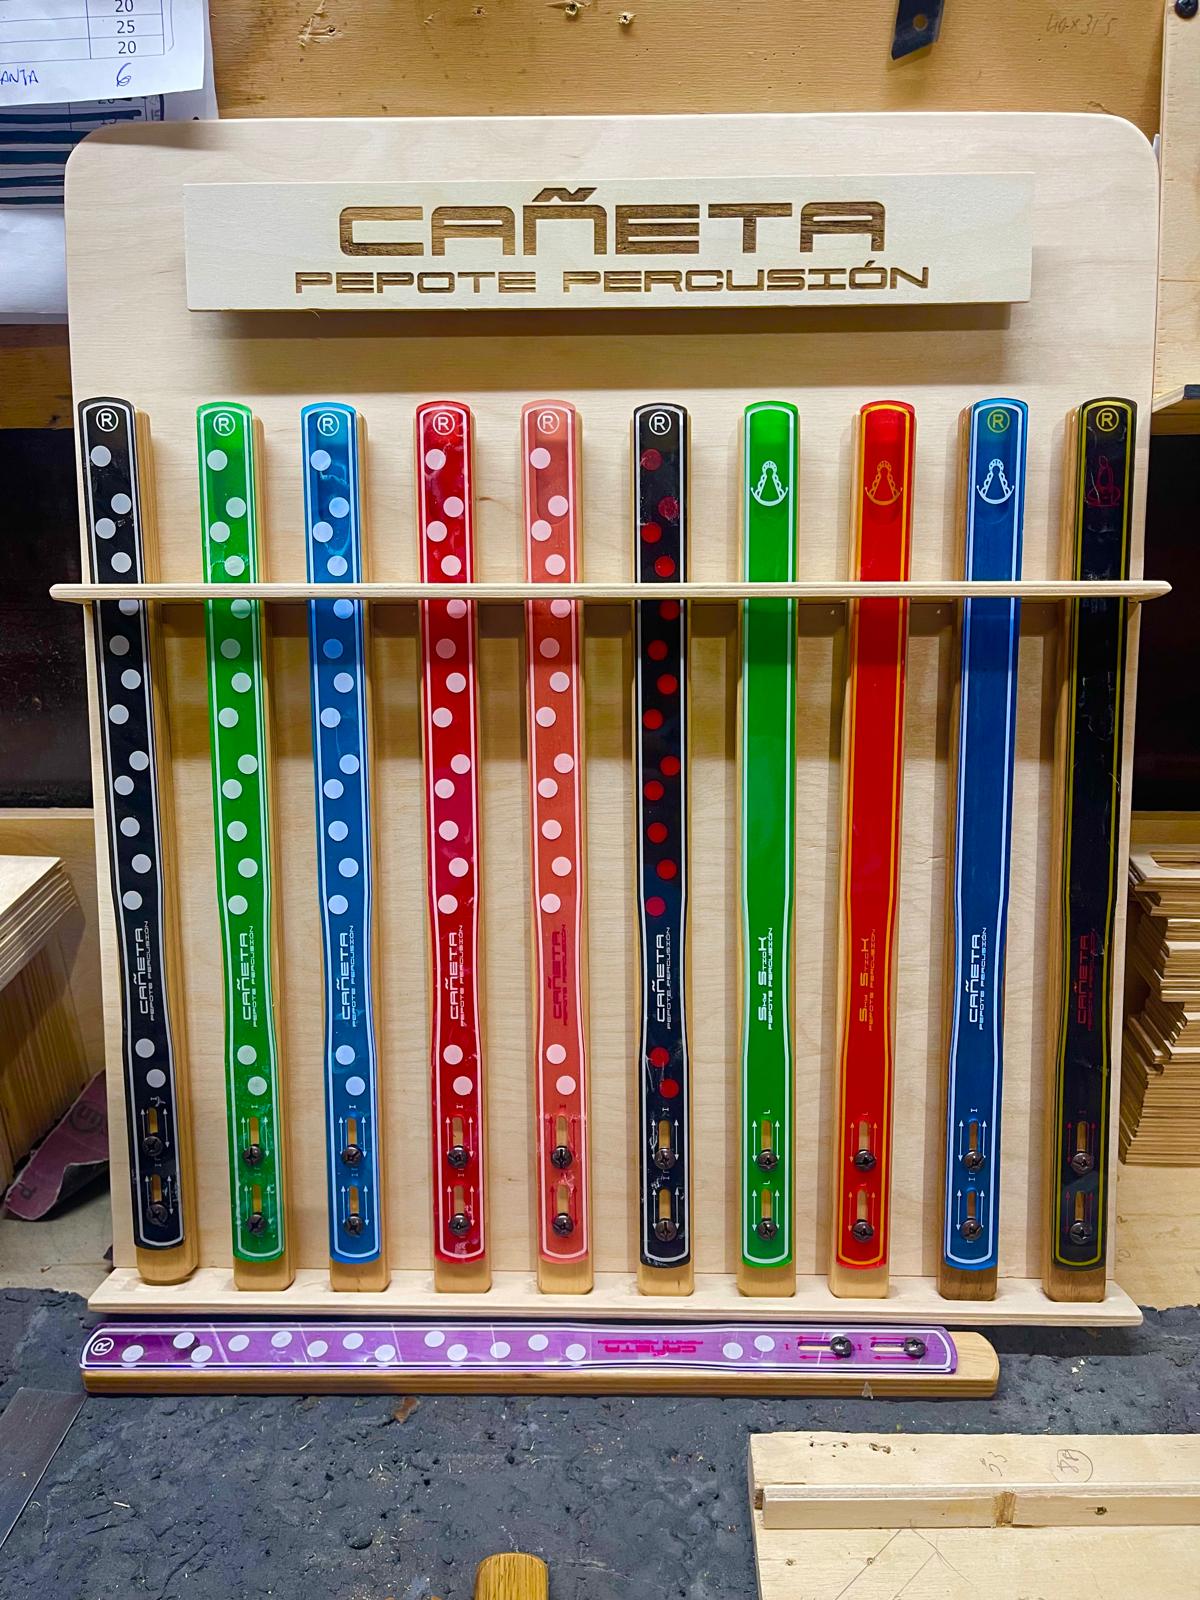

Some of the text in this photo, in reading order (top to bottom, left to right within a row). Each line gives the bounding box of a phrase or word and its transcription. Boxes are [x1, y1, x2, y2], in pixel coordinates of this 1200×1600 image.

[114, 0, 134, 12] 20
[116, 20, 135, 34] 25
[118, 40, 137, 54] 20
[339, 186, 886, 257] CAÑETA
[295, 260, 930, 294] PEPOTE PERCUSIÓN
[133, 928, 148, 1014] CAÑETA
[237, 933, 251, 1020] CAÑETA
[337, 932, 350, 1019] CAÑETA
[445, 932, 459, 1019] CAÑETA
[548, 932, 562, 1019] CAÑETA
[652, 934, 665, 1022] CAÑETA
[966, 935, 980, 1022] CAÑETA
